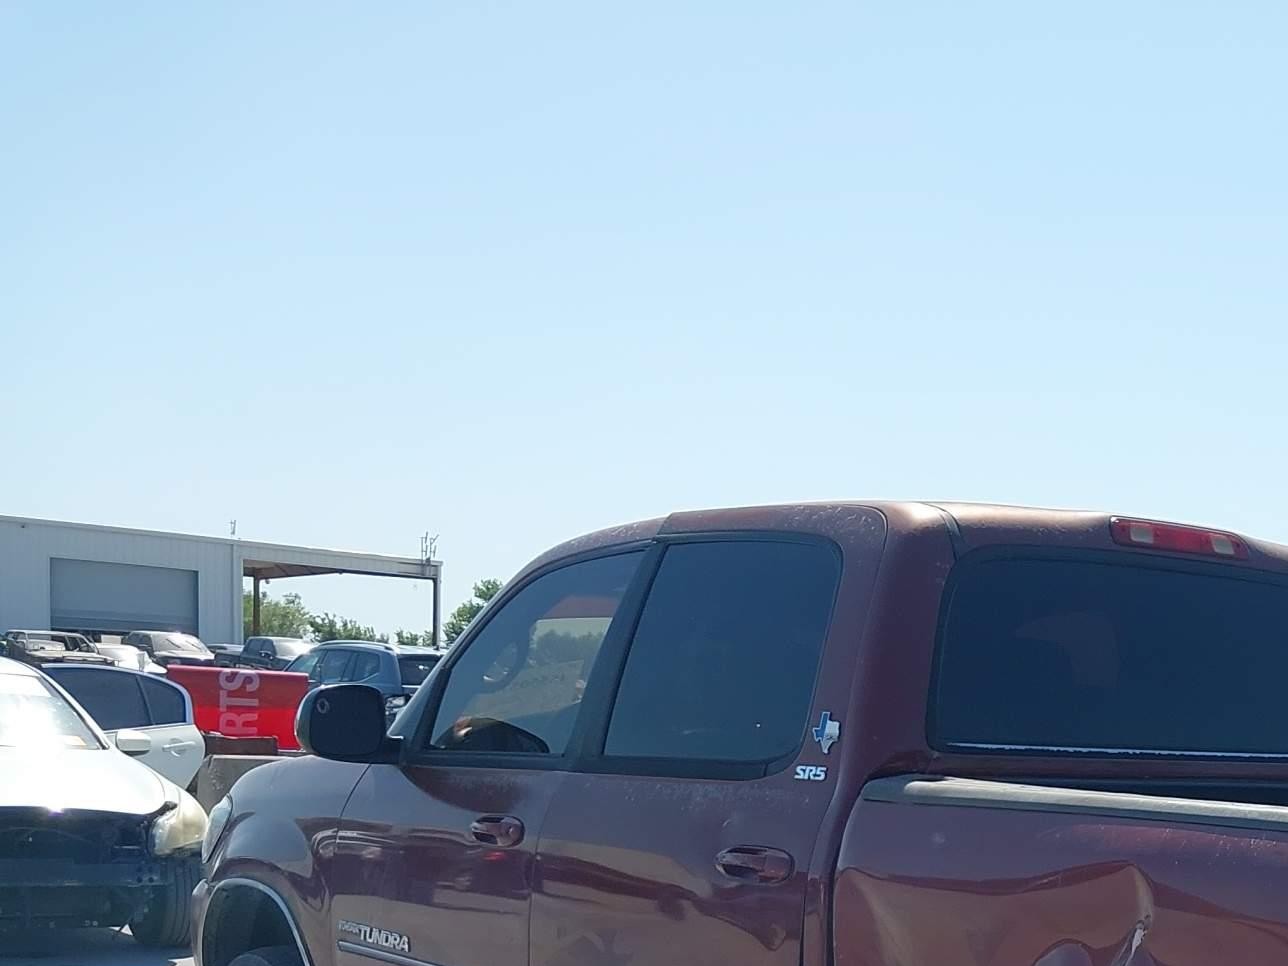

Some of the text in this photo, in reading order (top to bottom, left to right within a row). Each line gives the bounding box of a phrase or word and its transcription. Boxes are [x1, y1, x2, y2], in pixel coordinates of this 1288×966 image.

[219, 670, 260, 735] RTS
[794, 765, 827, 780] SR5
[359, 925, 410, 952] TUNDRA
